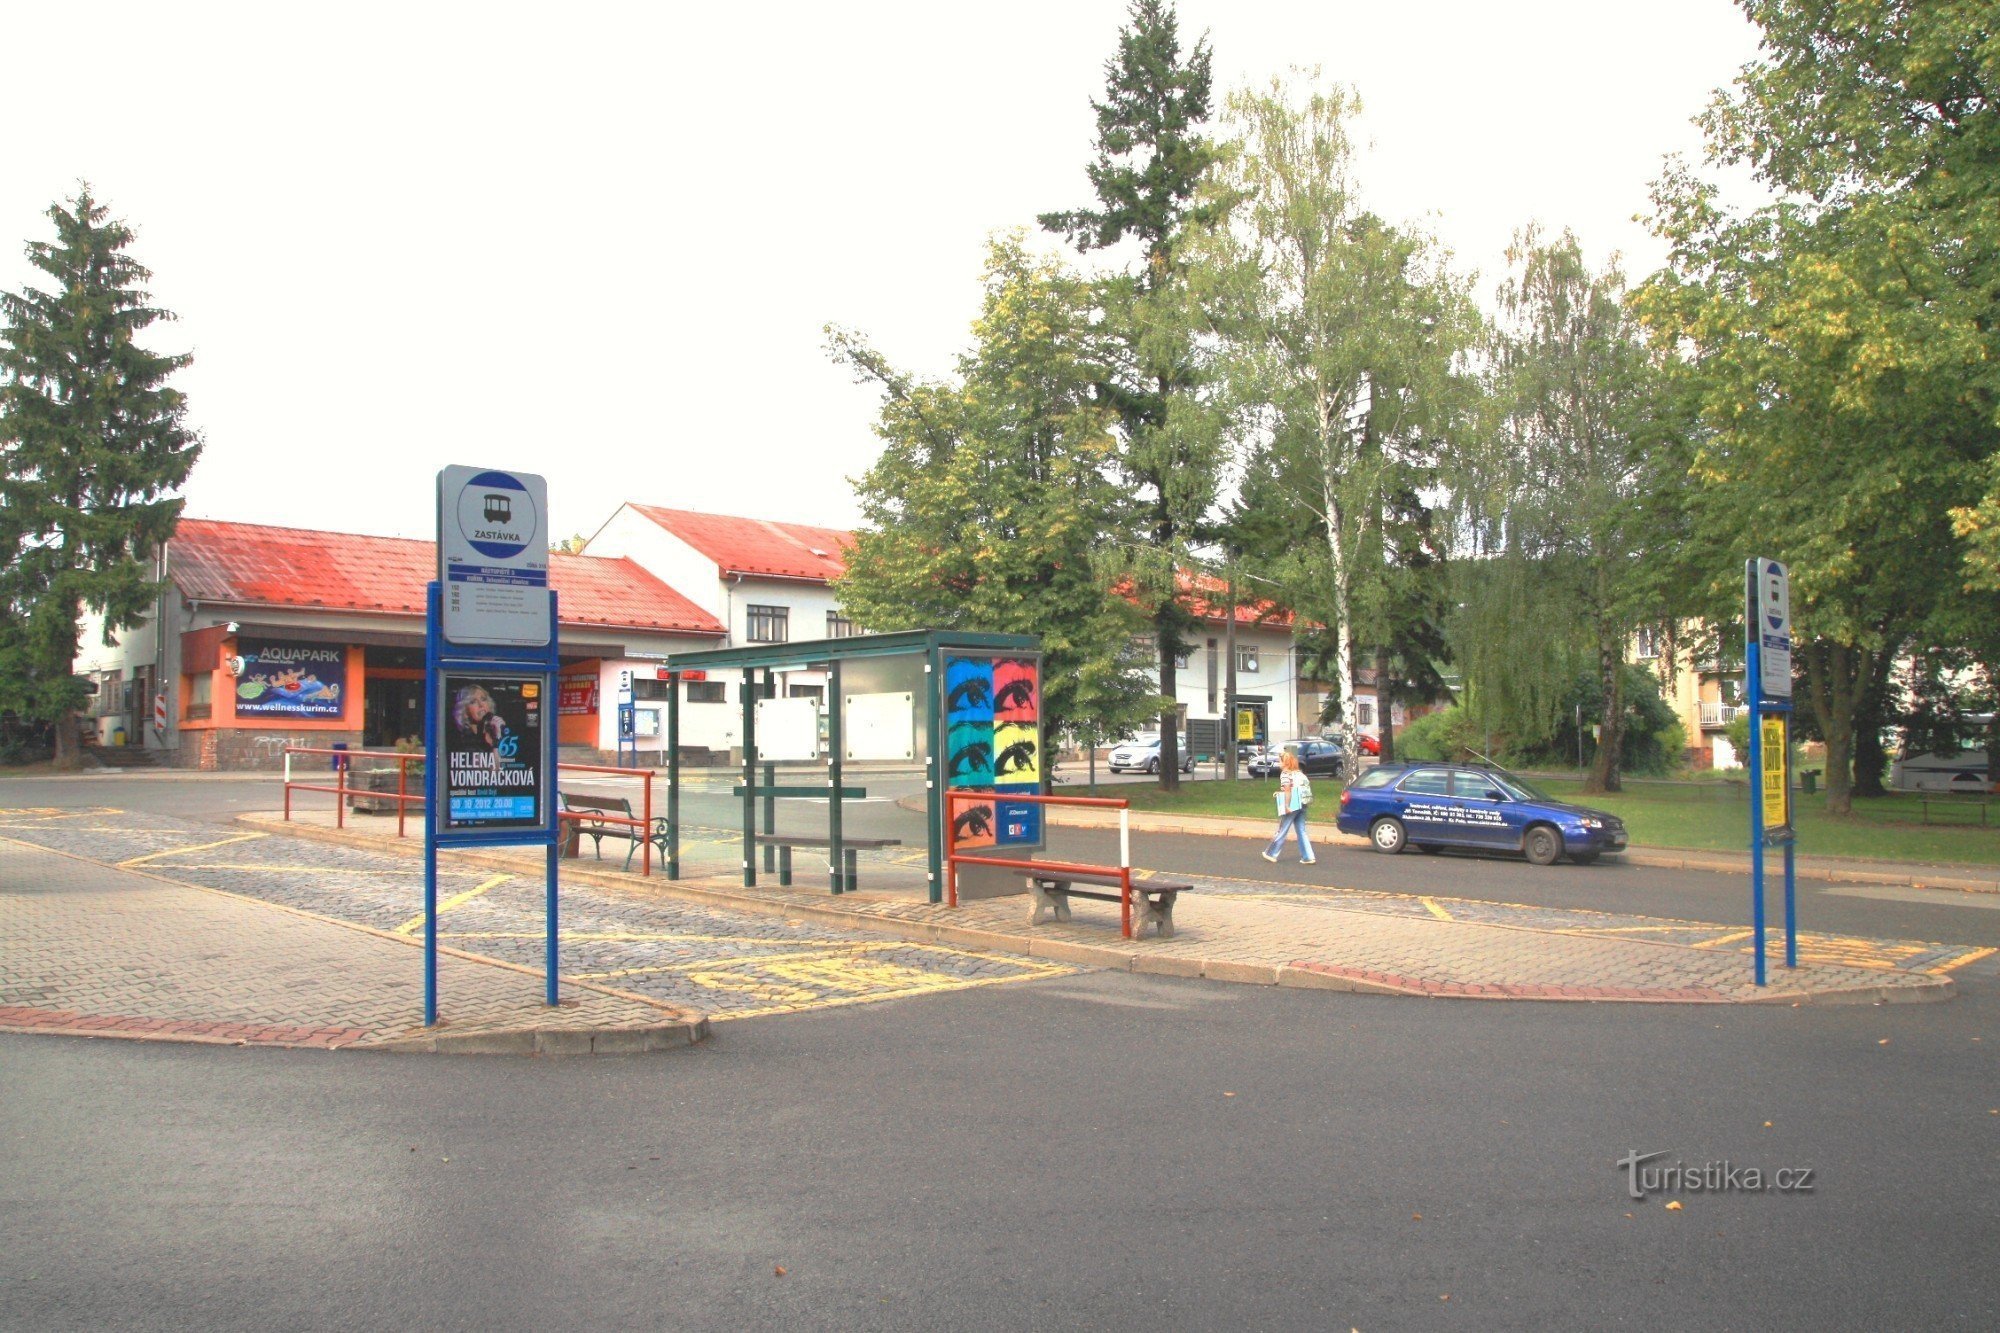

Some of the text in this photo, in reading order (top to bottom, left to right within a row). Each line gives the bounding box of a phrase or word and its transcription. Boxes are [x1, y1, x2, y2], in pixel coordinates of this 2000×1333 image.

[474, 530, 520, 541] ZASTÁVKA
[260, 647, 340, 662] AQUAPARK
[236, 703, 338, 713] www.wellnesskurim.cz
[499, 735, 518, 757] 65
[450, 752, 496, 769] HELENA
[450, 767, 534, 787] VONDRÁČKOVÁ
